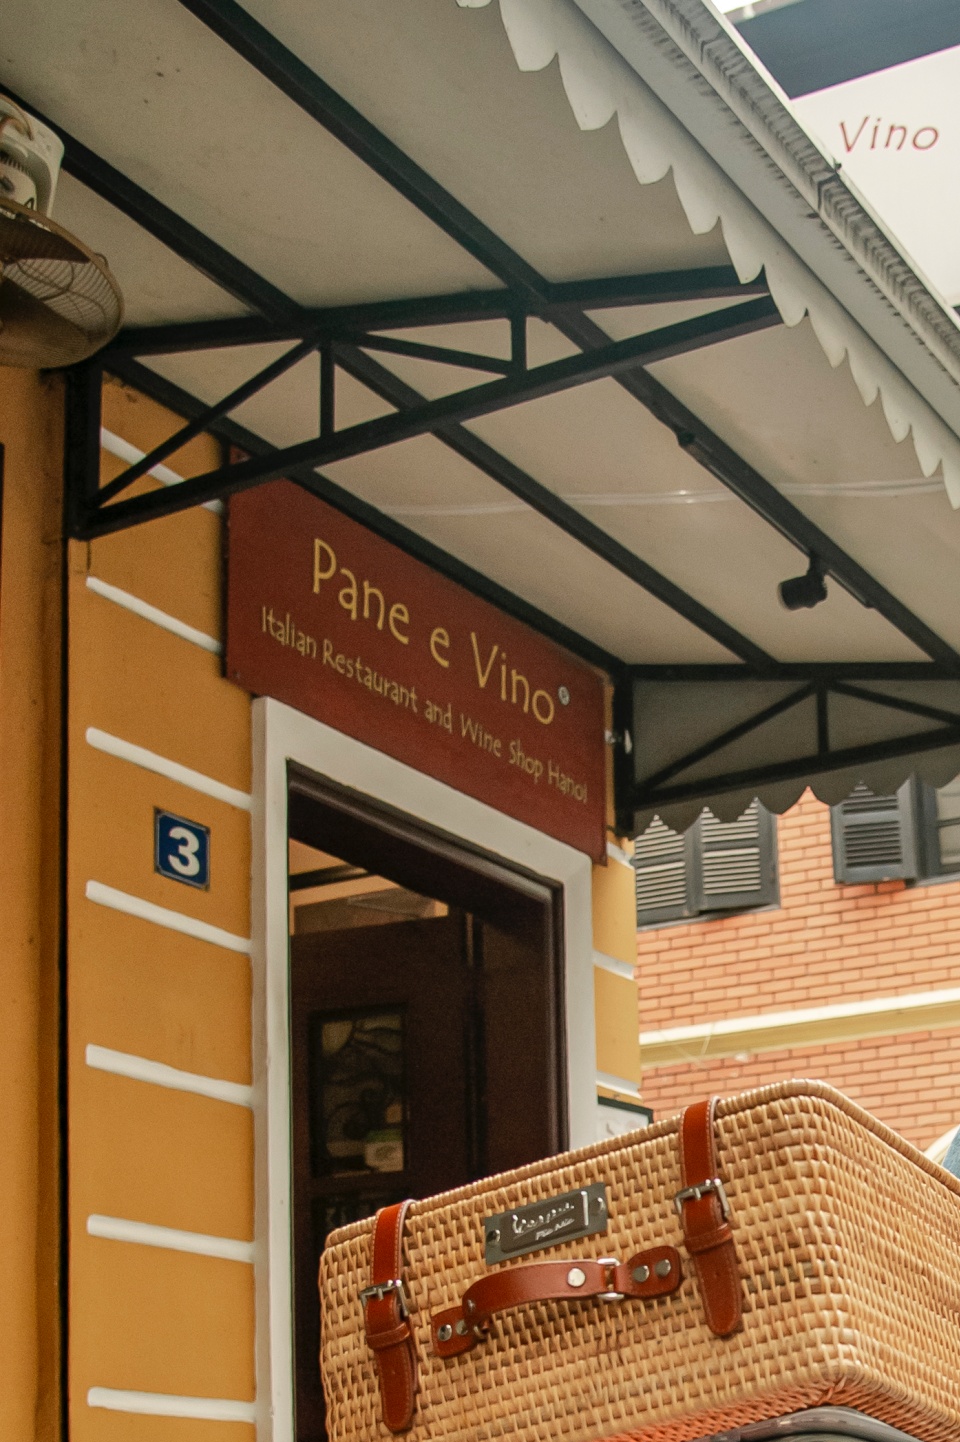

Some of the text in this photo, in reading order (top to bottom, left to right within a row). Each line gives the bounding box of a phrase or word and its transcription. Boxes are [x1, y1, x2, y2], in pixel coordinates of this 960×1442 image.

[839, 114, 939, 153] Vino
[313, 538, 410, 645] Pane
[430, 626, 450, 668] e
[262, 605, 588, 804] Italian Restaurant and Wine Shop Hanoi
[167, 826, 200, 877] 3
